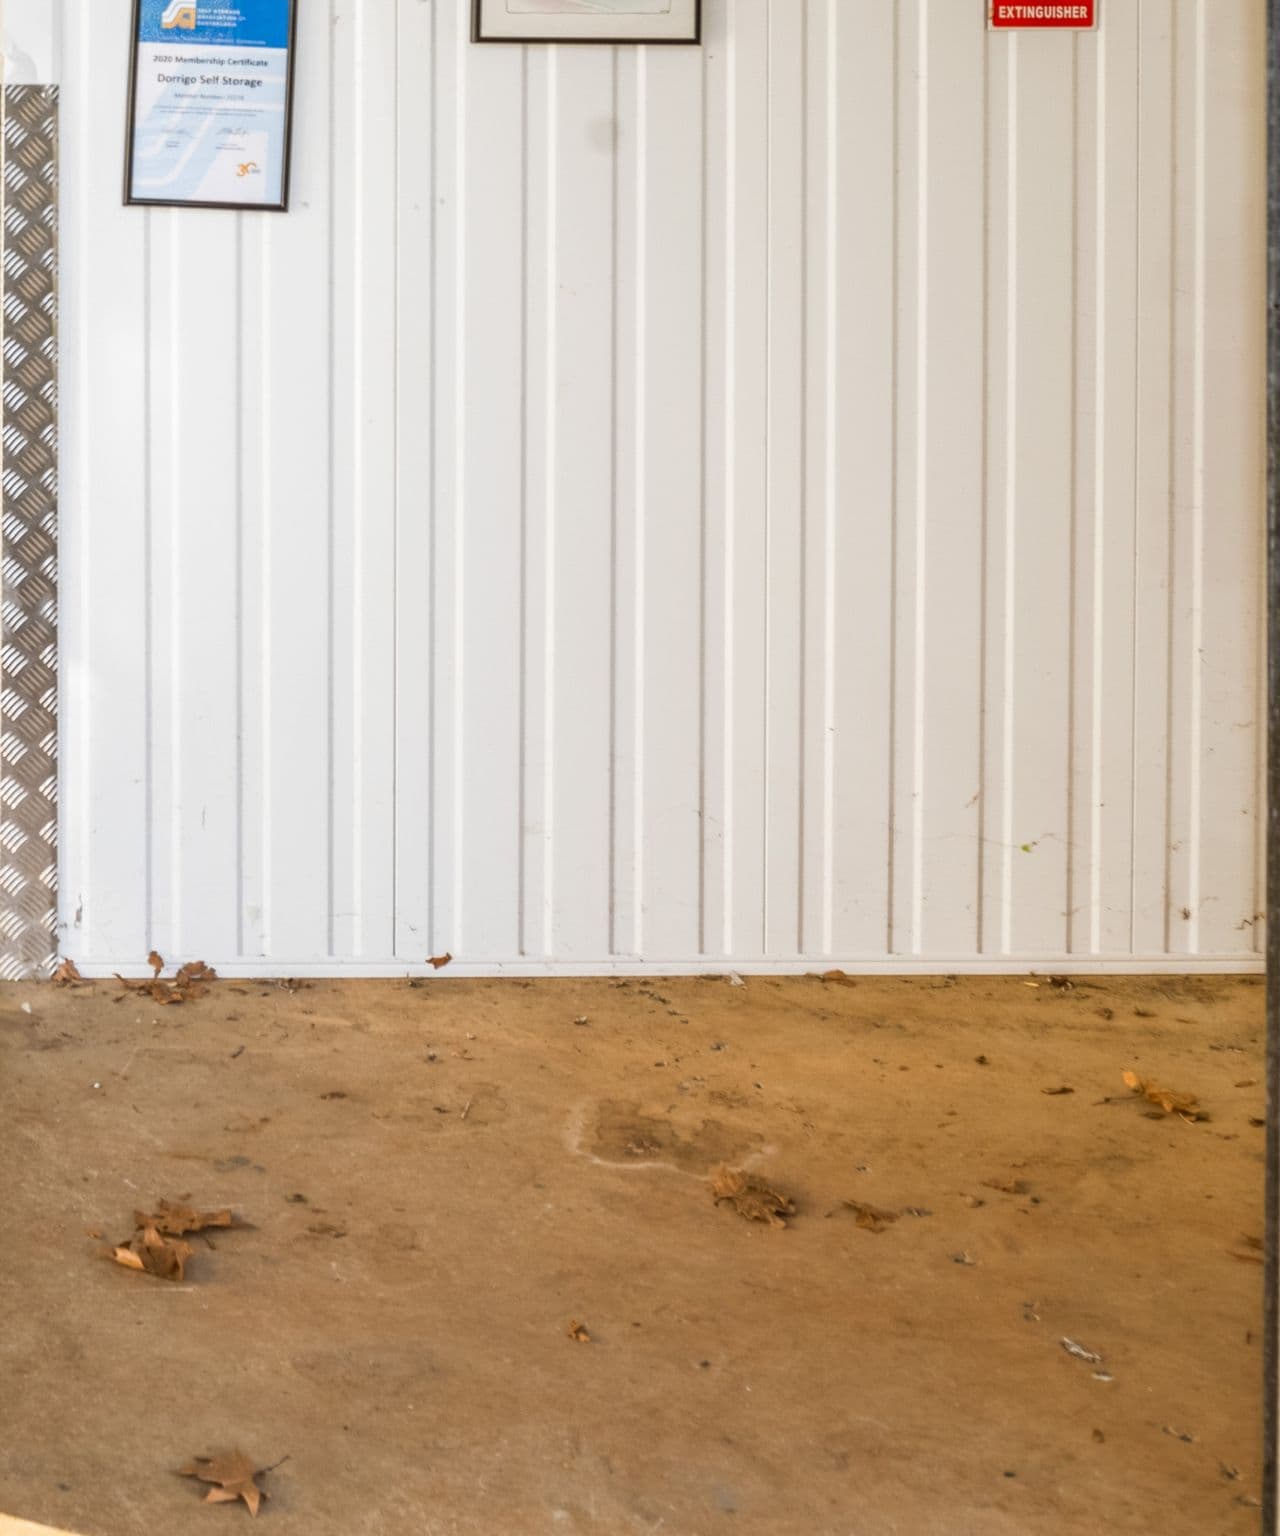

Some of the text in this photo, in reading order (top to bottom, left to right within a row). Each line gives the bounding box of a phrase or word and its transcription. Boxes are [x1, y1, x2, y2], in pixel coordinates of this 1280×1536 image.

[998, 6, 1088, 19] EXTINGUISHER
[153, 55, 269, 68] 2020 Membership Certificate
[157, 73, 263, 89] Dorrigo Self Storage
